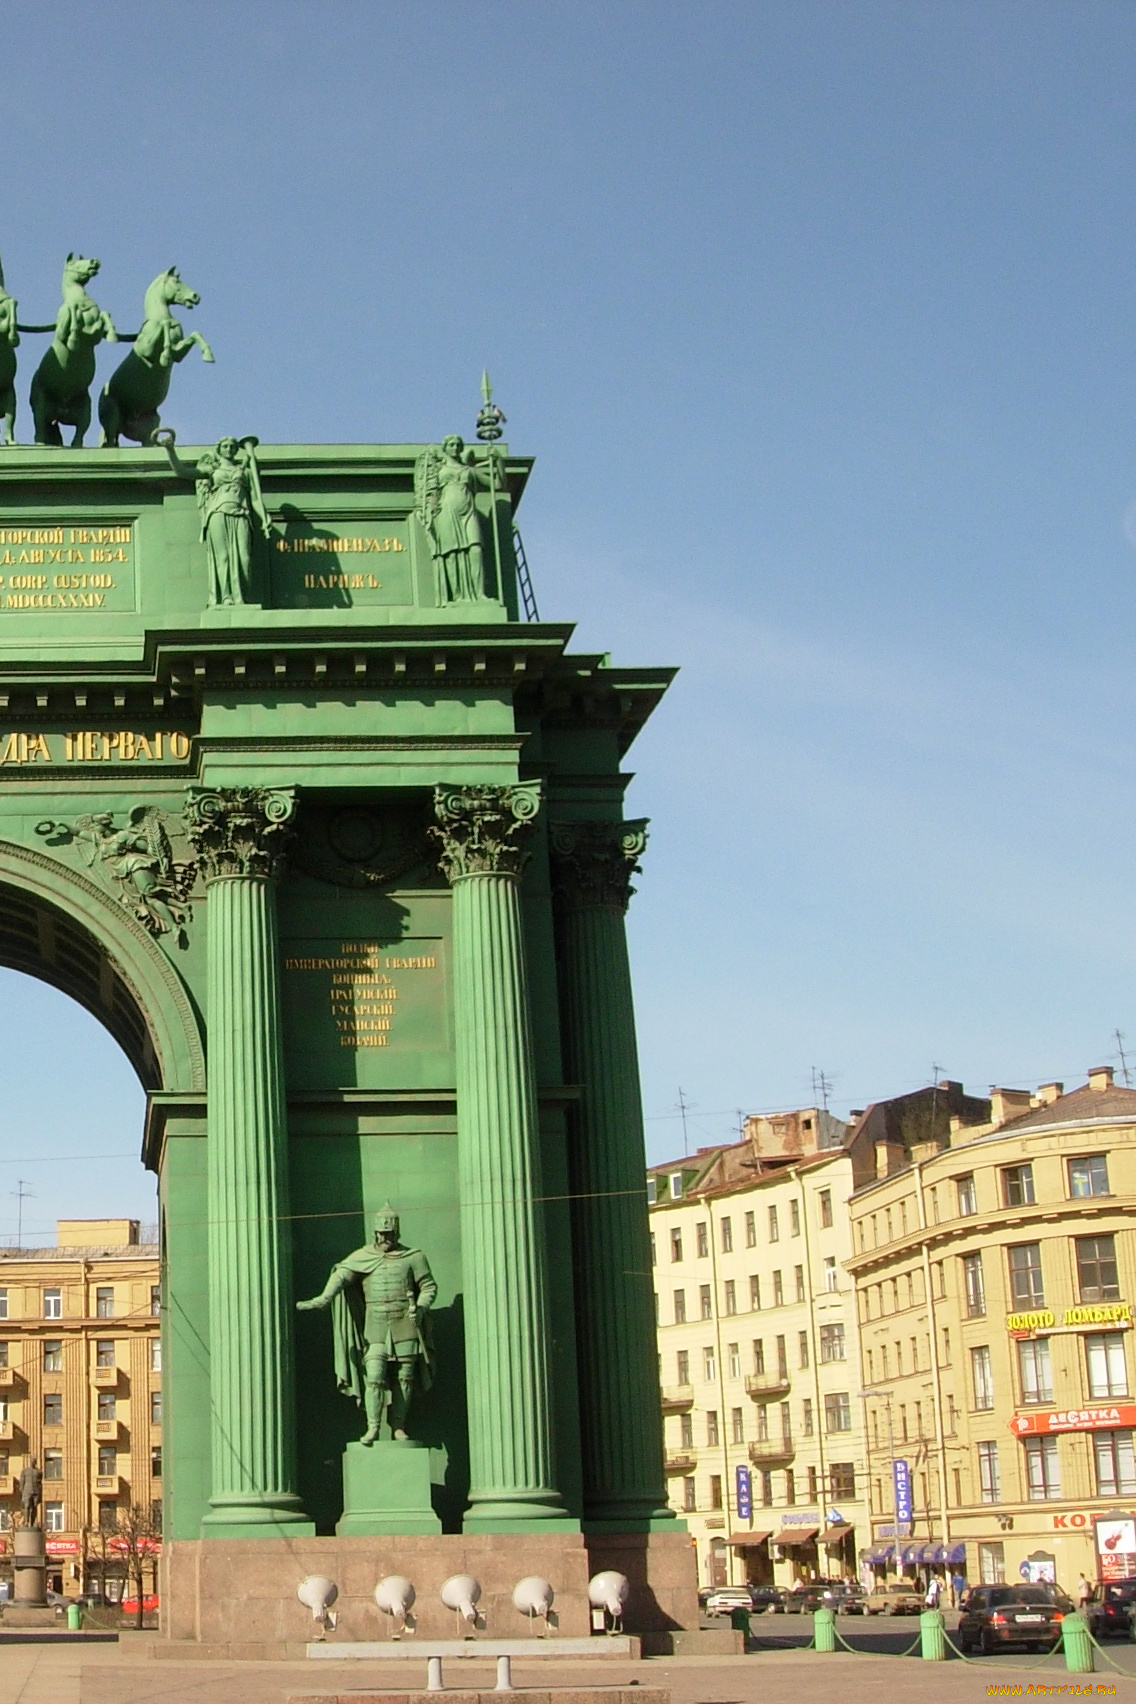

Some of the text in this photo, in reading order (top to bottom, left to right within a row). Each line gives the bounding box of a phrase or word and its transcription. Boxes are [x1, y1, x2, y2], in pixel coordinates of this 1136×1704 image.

[19, 548, 85, 564] АВГУСТА
[9, 574, 48, 590] CORP.
[53, 573, 116, 589] CUSTOD.
[64, 731, 191, 761] ПЕРВАГО
[1007, 1311, 1055, 1330] ЗОЛОТО
[1064, 1305, 1131, 1325] ЛОМБАРД
[896, 1462, 908, 1519] БИСТРО
